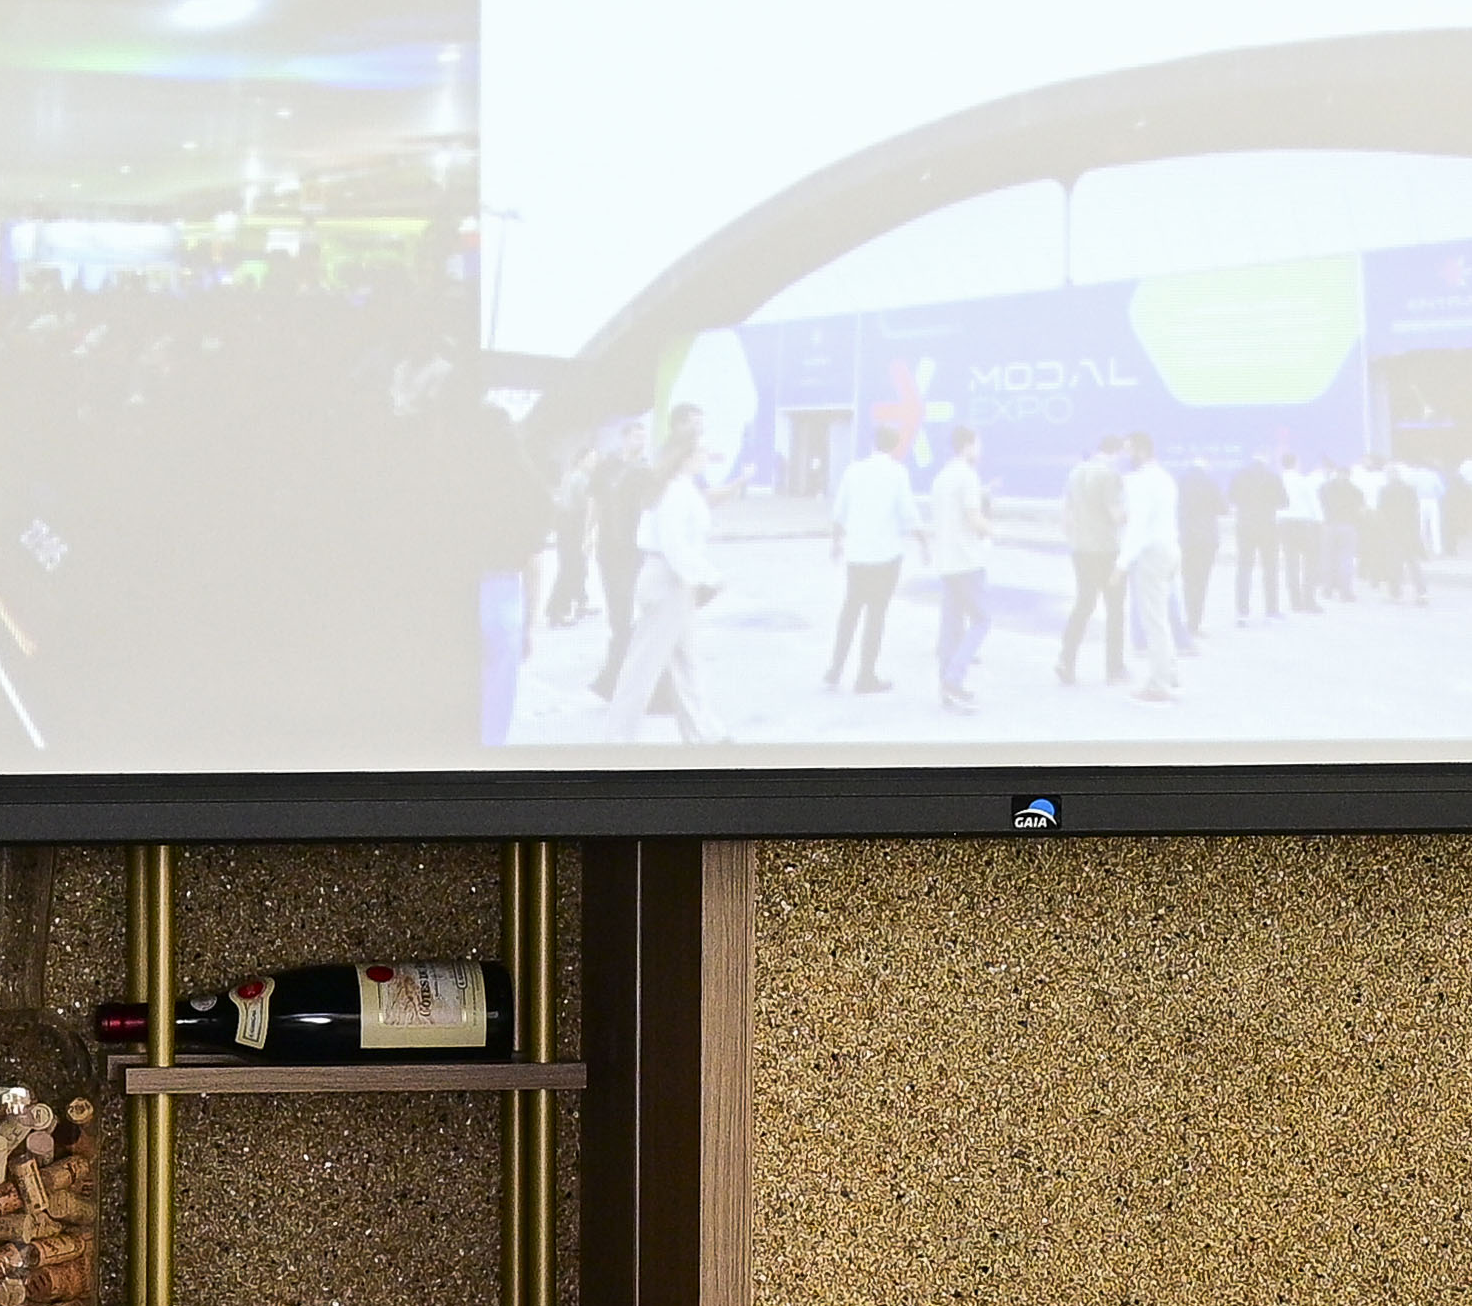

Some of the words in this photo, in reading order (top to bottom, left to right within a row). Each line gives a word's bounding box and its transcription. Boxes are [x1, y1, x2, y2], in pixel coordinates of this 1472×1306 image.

[967, 355, 1138, 392] MODAL
[967, 393, 1074, 425] EXPO
[1014, 816, 1048, 828] GAIA
